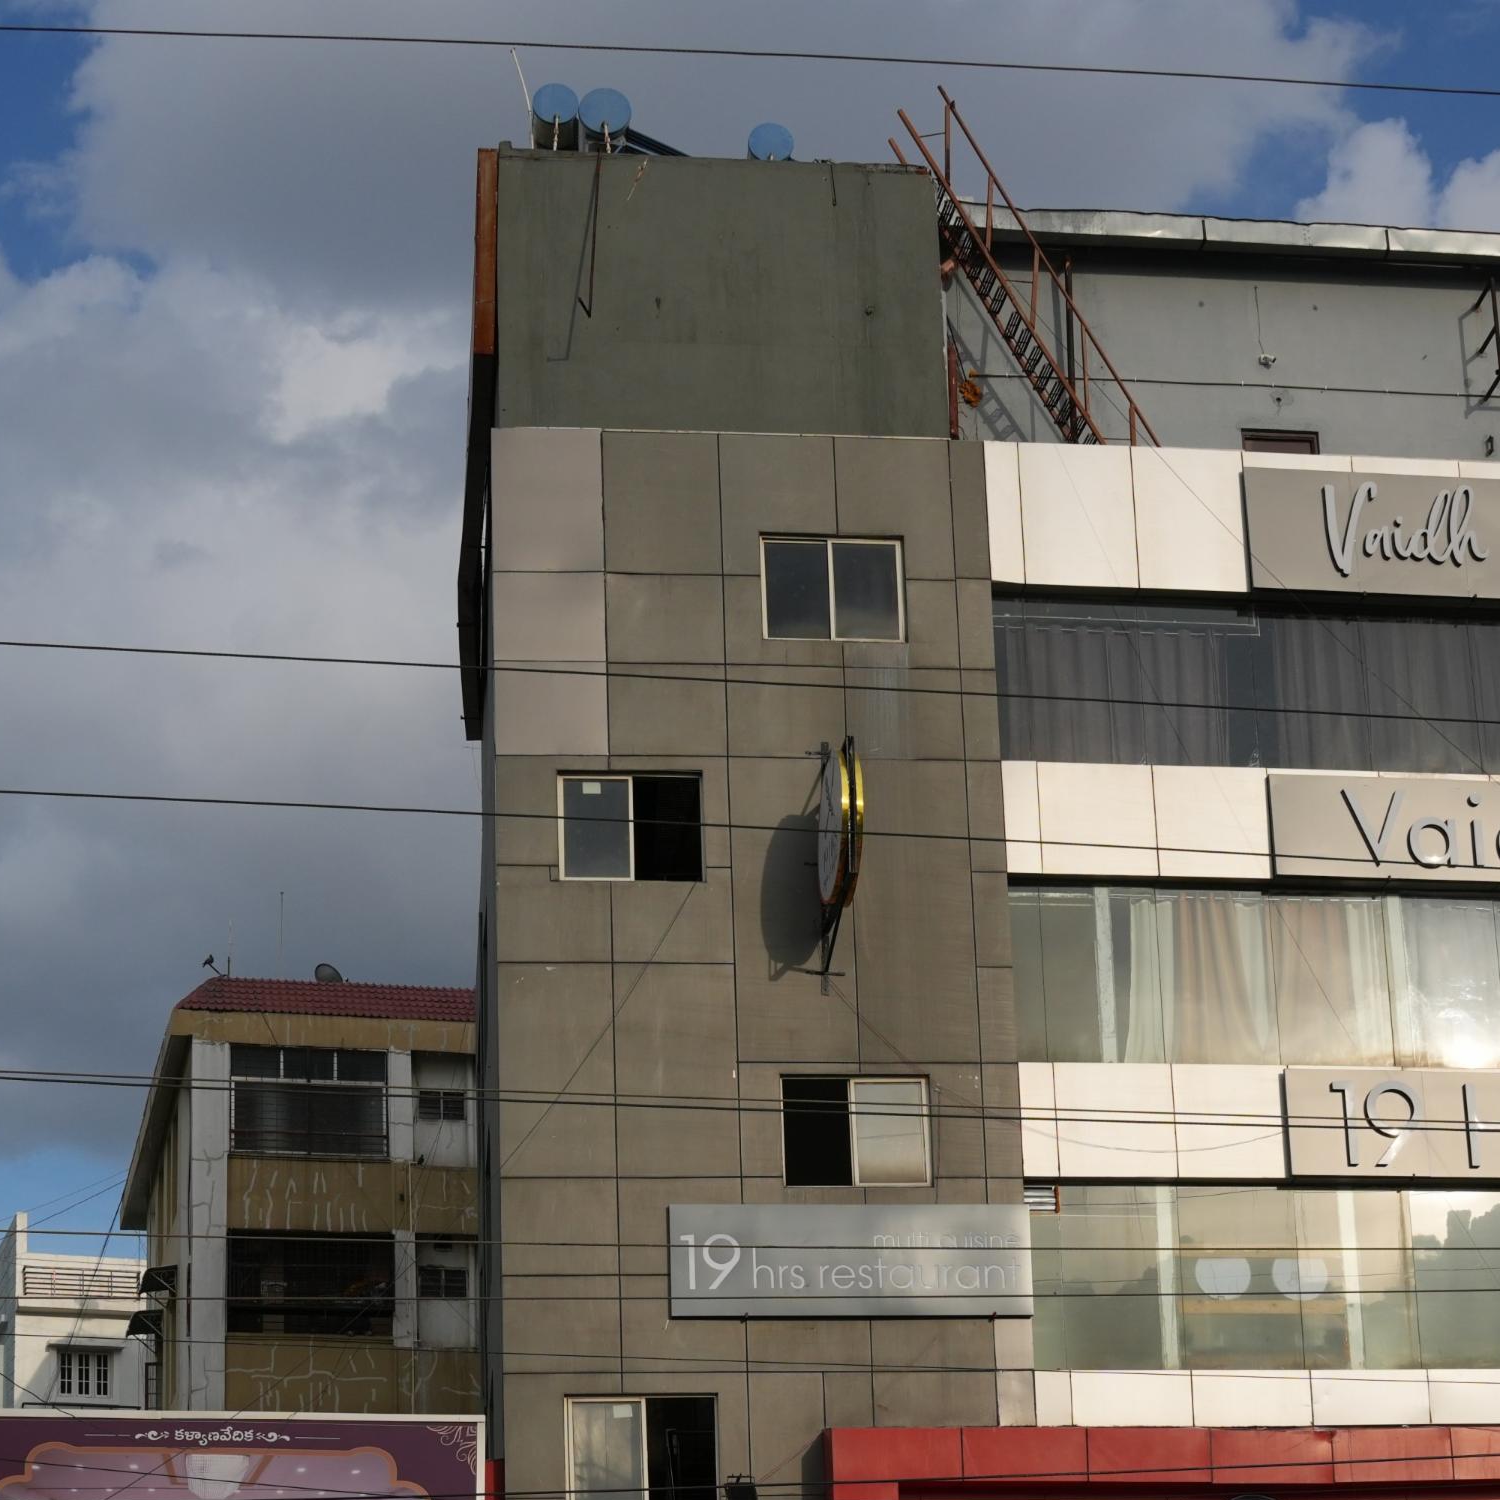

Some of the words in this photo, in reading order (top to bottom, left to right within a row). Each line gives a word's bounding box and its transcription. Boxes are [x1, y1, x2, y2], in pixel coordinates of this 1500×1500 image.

[1322, 480, 1490, 577] Vaidh
[1328, 1079, 1424, 1168] 19
[679, 1232, 742, 1290] 19
[752, 1246, 806, 1290] hrs
[819, 1256, 1022, 1290] restaurant
